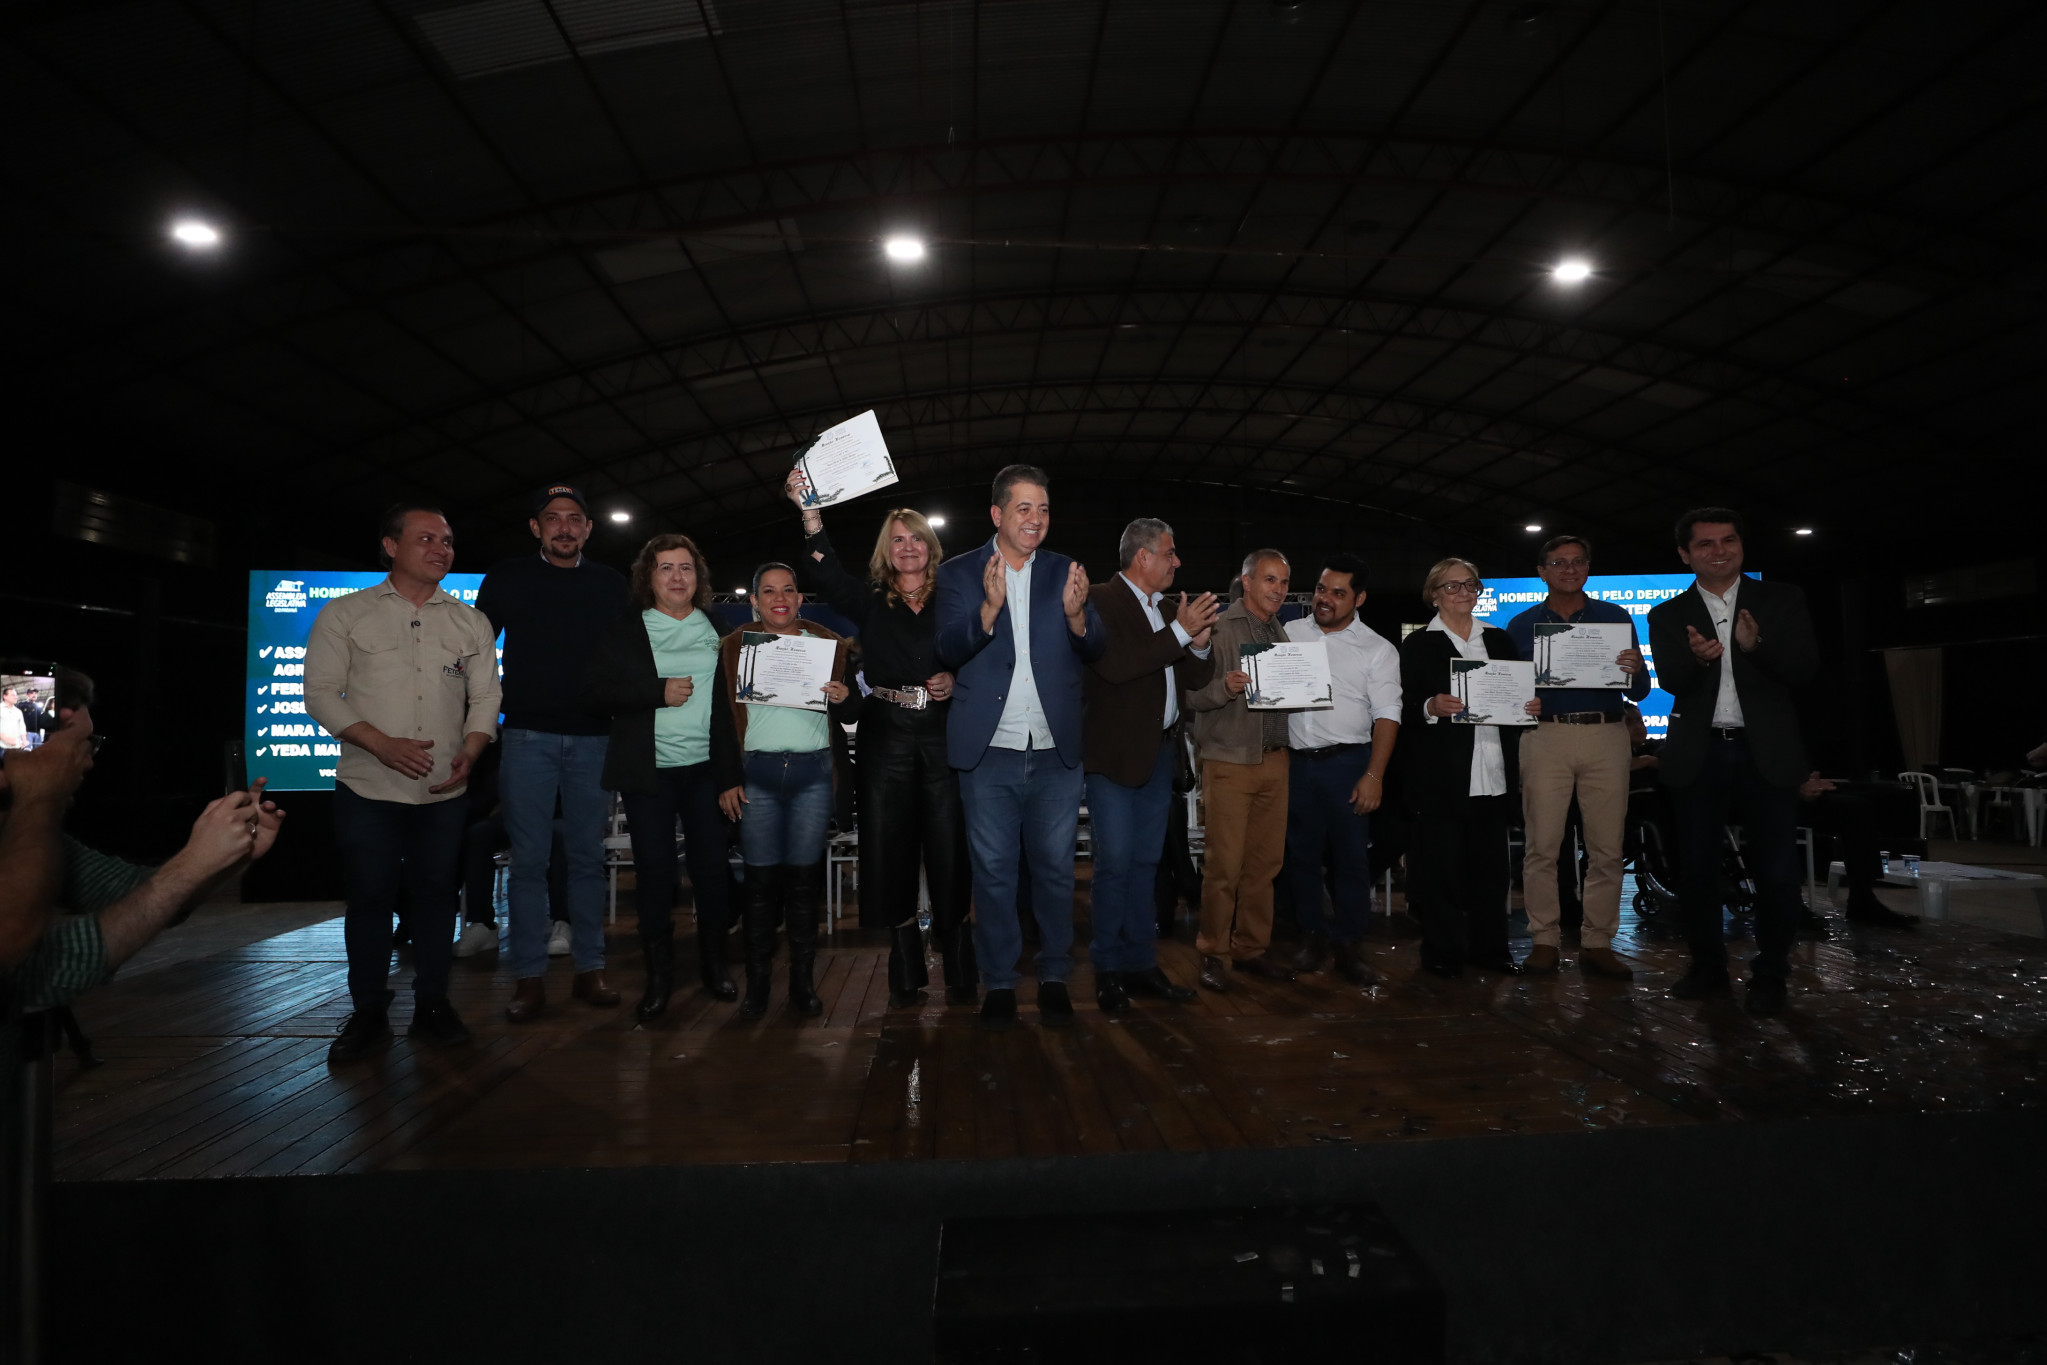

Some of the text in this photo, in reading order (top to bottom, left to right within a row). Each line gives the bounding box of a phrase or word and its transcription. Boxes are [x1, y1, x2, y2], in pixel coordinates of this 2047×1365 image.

[265, 592, 307, 600] ASSEMBLEIA
[1602, 590, 1634, 601] PELO
[265, 600, 307, 608] LEGISLATIVA
[274, 646, 307, 659] ASS
[271, 682, 304, 695] FER
[271, 724, 315, 736] MARA
[269, 744, 311, 756] YEDA
